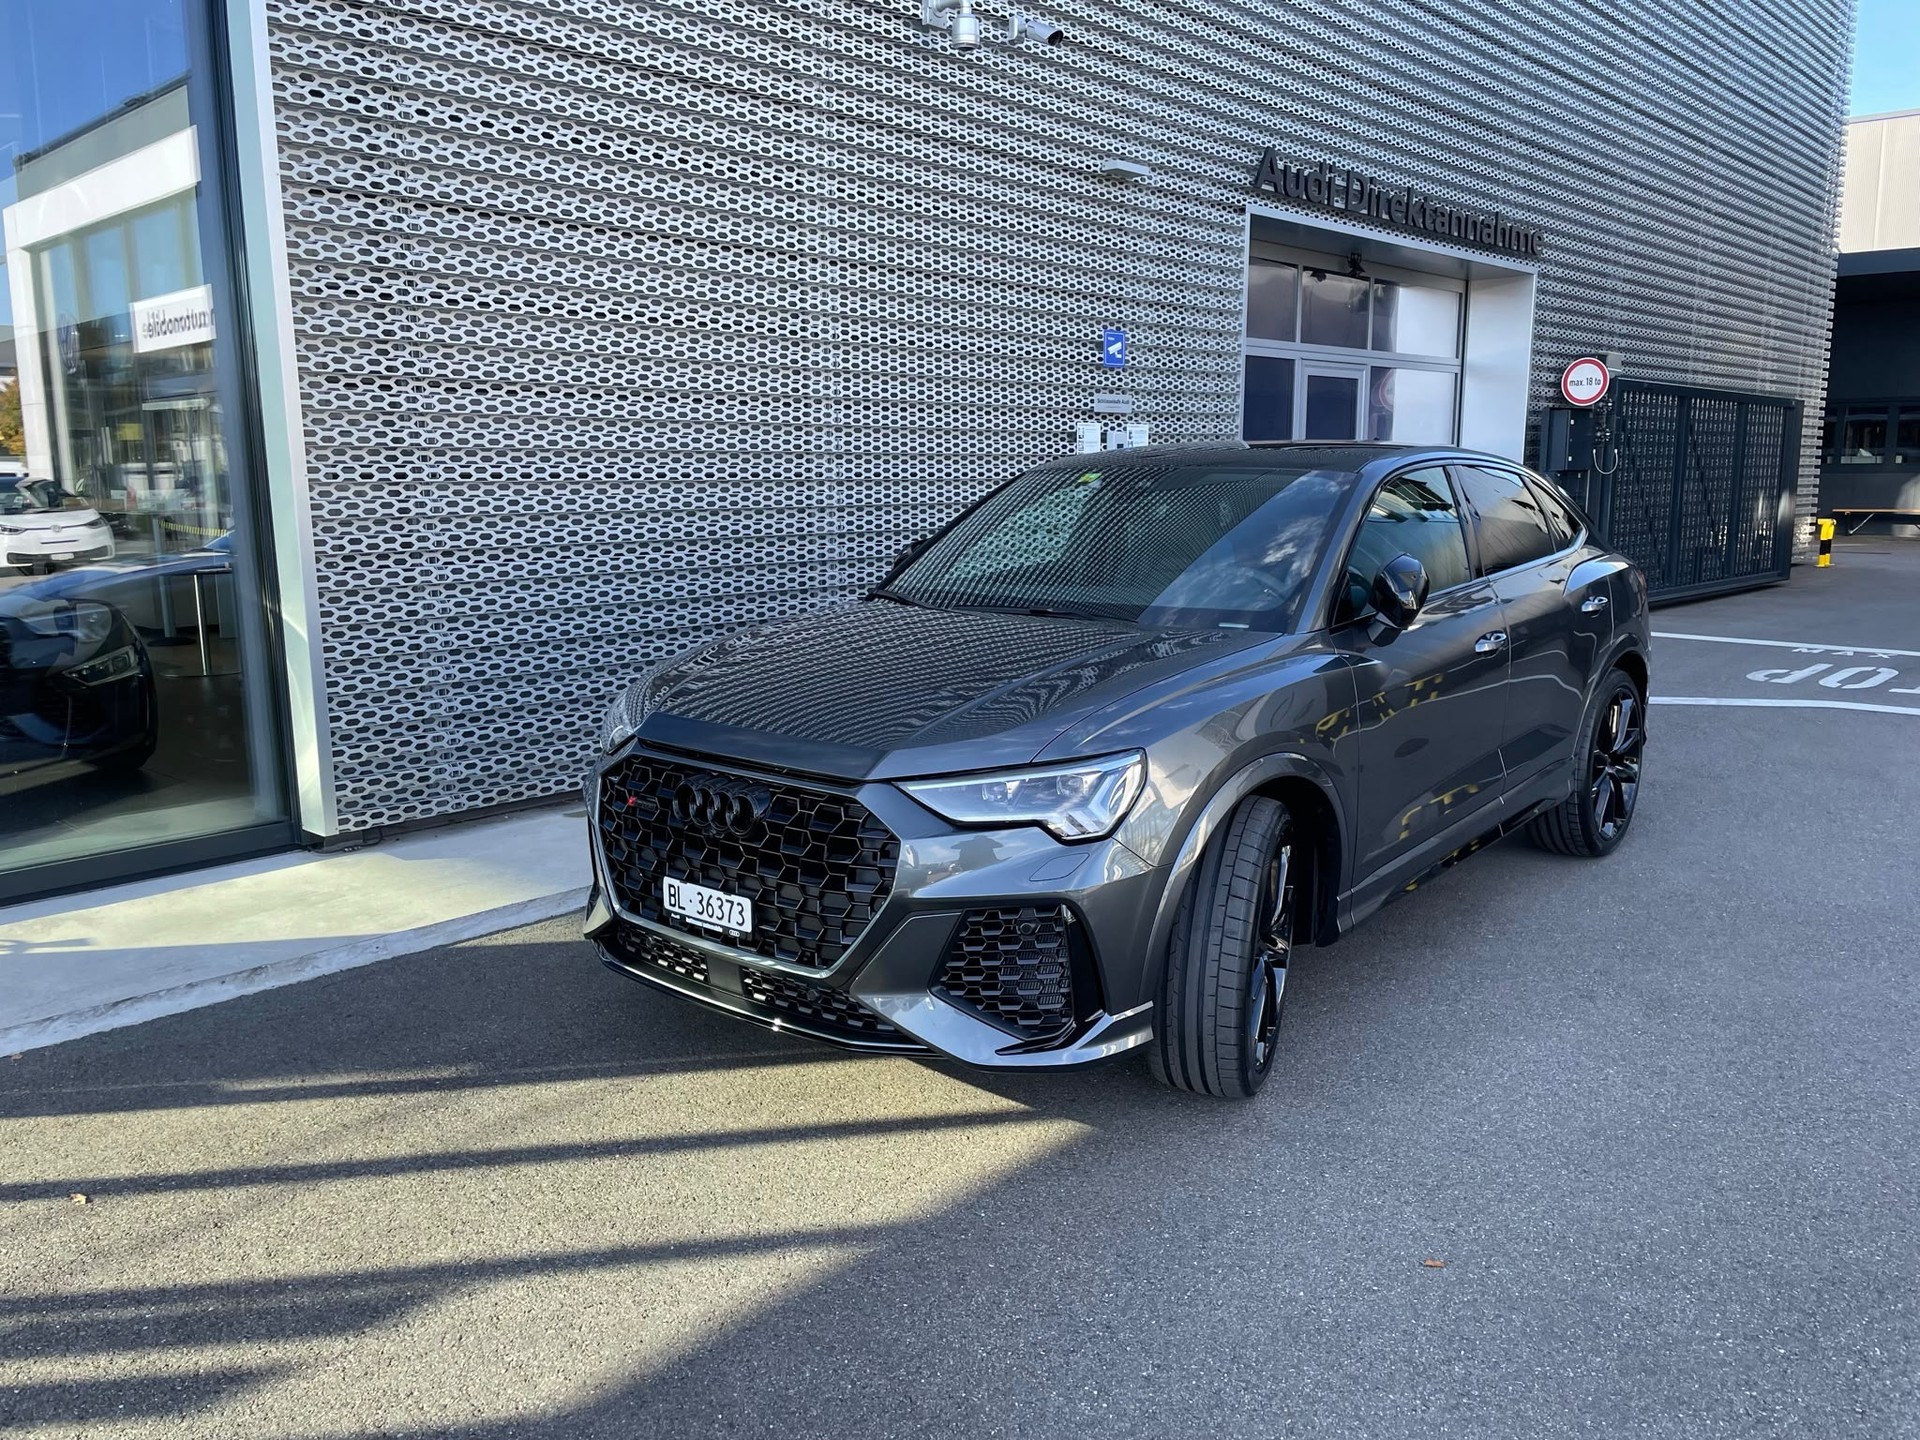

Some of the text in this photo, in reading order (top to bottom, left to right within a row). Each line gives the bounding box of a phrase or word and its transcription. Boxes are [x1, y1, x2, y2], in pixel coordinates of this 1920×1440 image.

[1253, 146, 1545, 256] Audi Direktannahme
[1586, 377, 1593, 386] 18
[1594, 378, 1601, 386] to
[668, 883, 686, 911] BL
[696, 891, 745, 927] 36373
